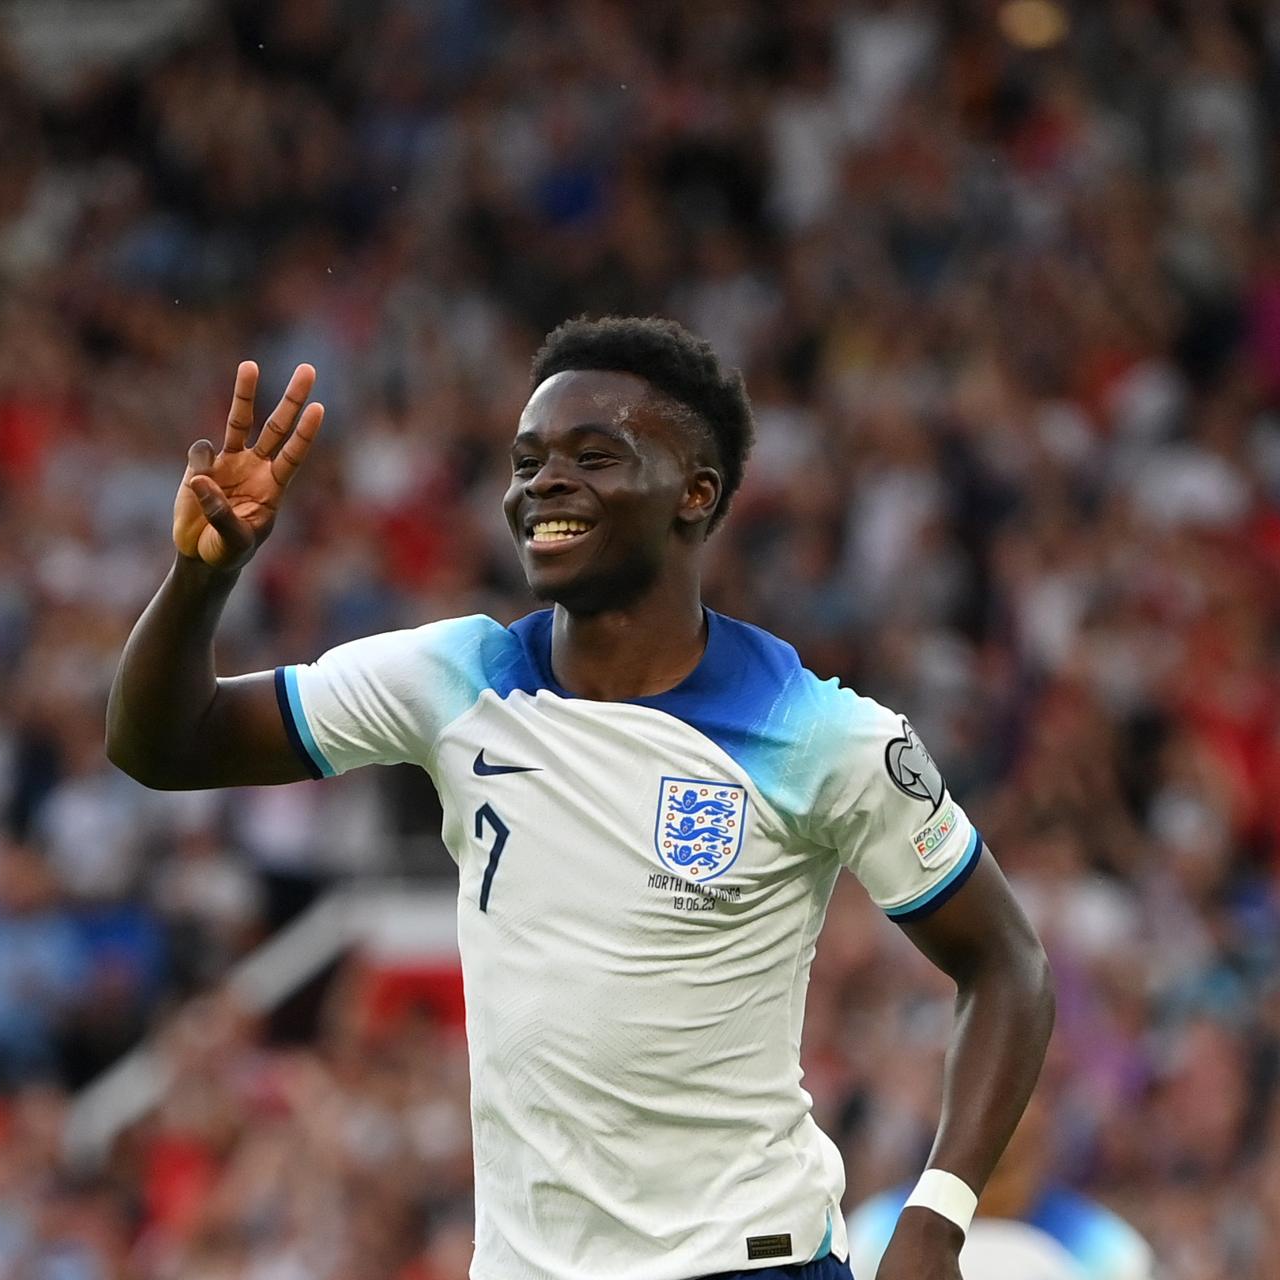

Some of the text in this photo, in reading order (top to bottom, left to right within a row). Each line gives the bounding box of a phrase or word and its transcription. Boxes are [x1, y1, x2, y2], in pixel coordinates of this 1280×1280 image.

[474, 802, 511, 914] 7
[647, 873, 682, 892] NORTH
[673, 896, 716, 911] 19.06.23
